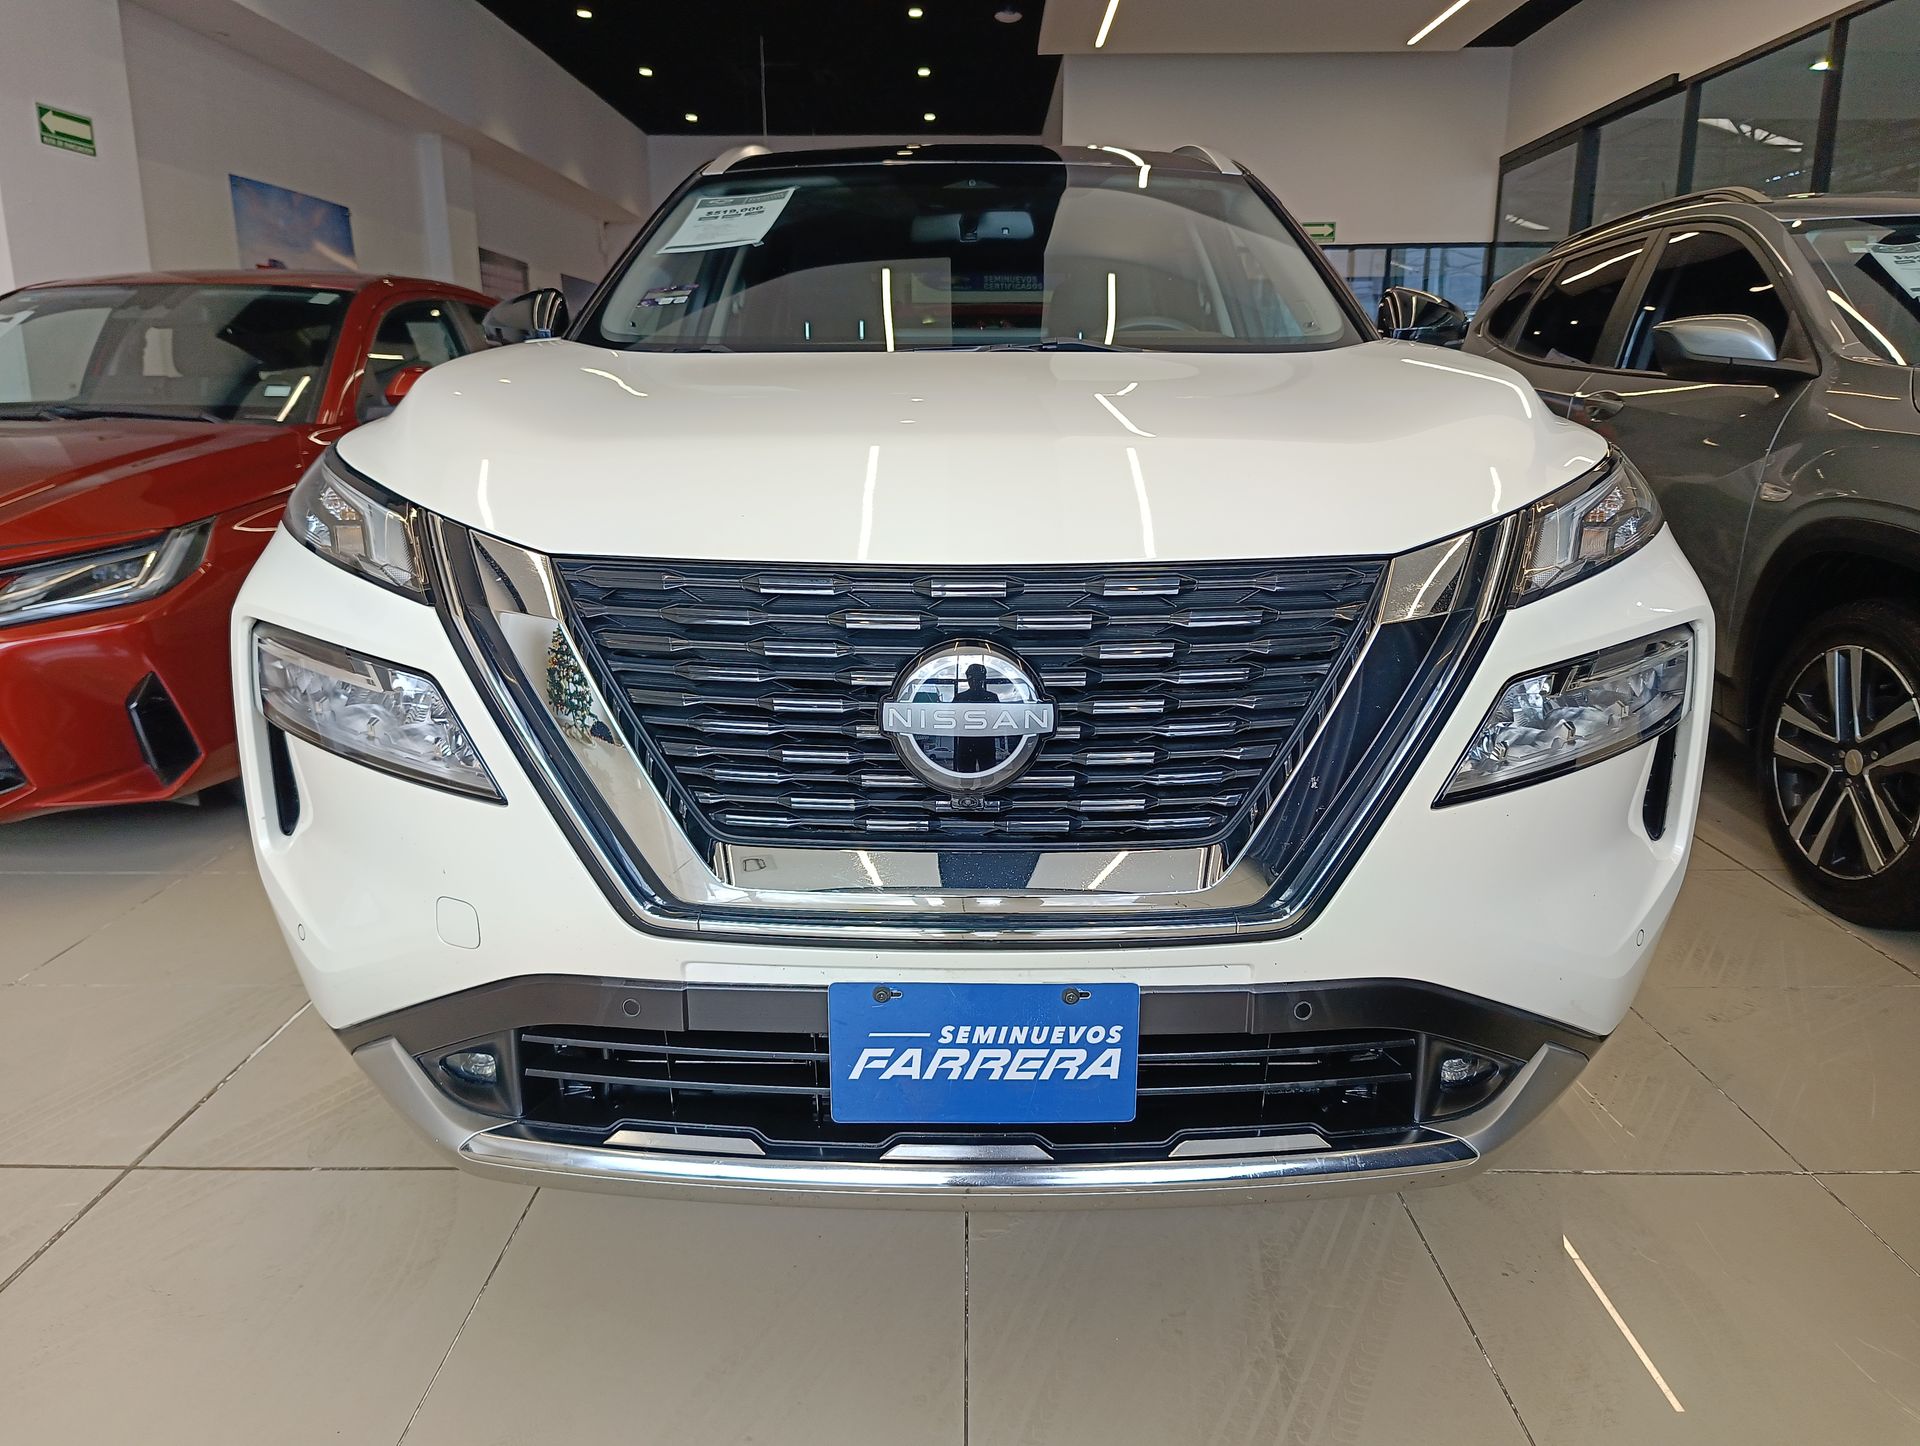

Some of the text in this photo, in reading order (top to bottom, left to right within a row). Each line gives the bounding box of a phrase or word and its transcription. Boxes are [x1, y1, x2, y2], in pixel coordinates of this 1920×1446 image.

[888, 708, 1048, 729] NISSAN
[937, 1025, 1123, 1045] SEMINUEVOS
[849, 1047, 1122, 1080] FARRERA
